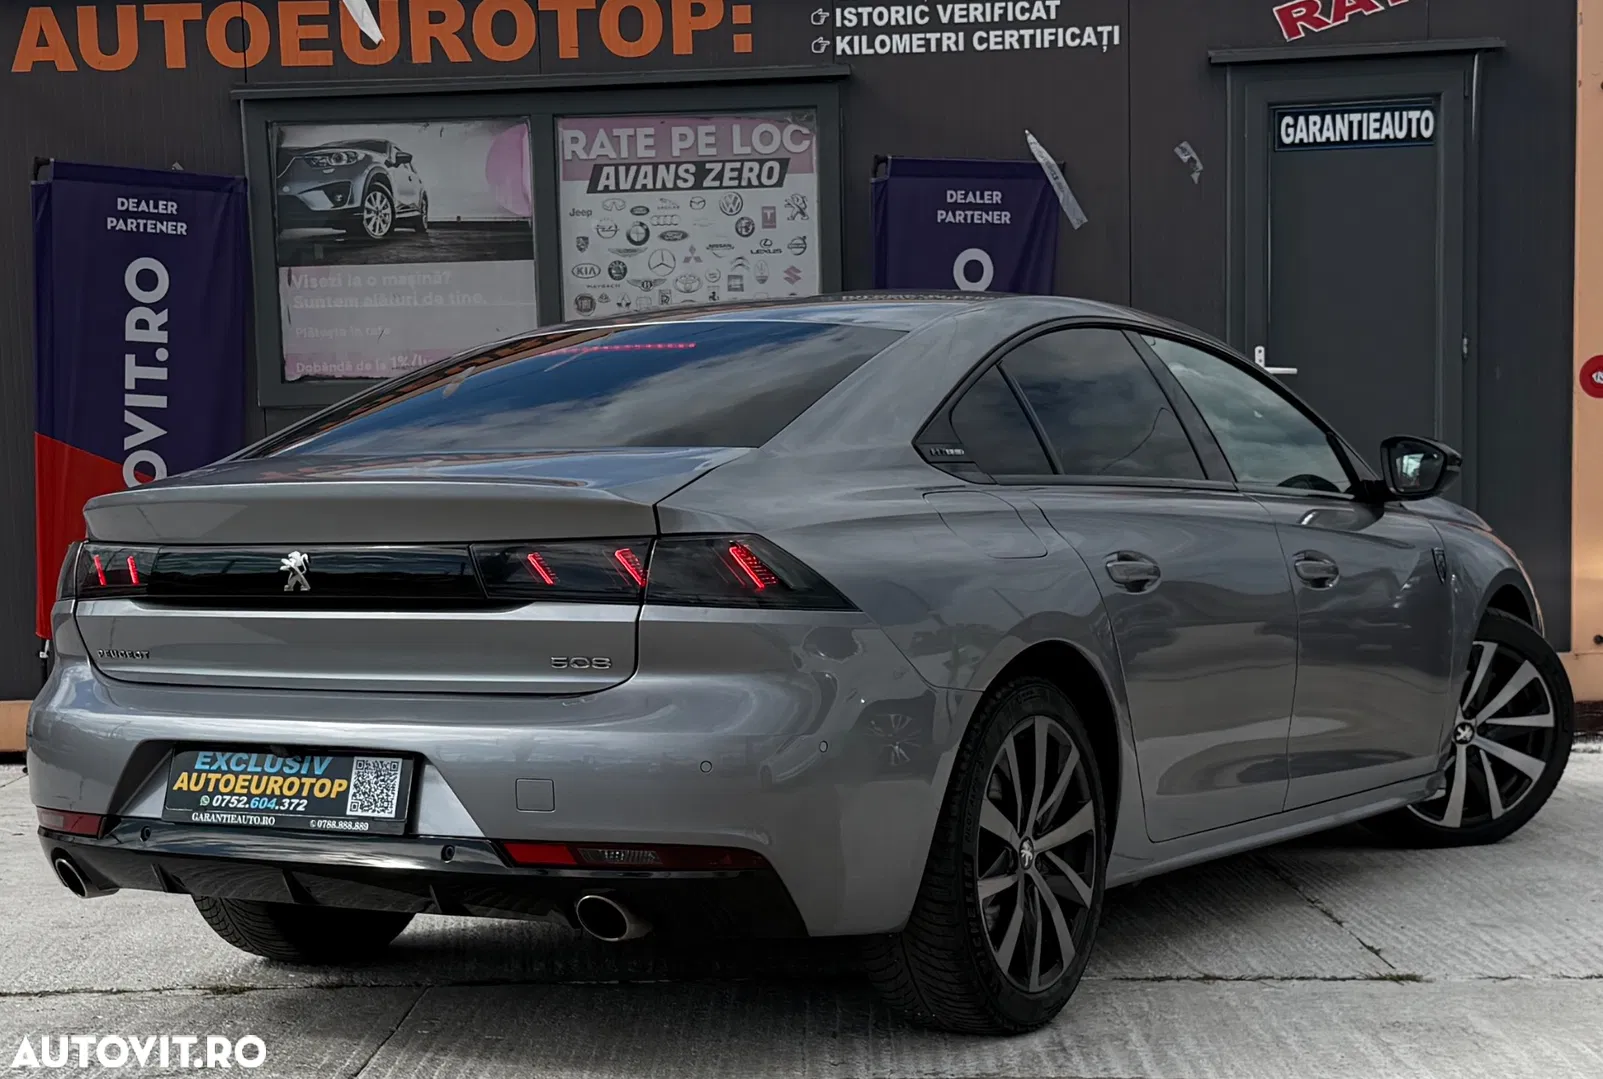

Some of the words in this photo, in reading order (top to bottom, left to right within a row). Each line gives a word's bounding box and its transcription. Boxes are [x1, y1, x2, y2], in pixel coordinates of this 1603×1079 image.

[836, 5, 930, 28] ISTORIC
[937, 0, 1061, 25] VERIFICAT
[1273, 0, 1409, 42] RA
[11, 0, 753, 72] AUTOEUROTOP:
[836, 32, 965, 56] KILOMETRI
[972, 25, 1120, 53] CERTIFICAȚI
[1280, 110, 1435, 145] GARANTIEAUTO
[563, 127, 656, 160] RATE
[671, 125, 718, 157] PE
[732, 123, 812, 155] LOC
[597, 163, 696, 191] AVANS
[703, 161, 781, 187] ZERO
[946, 190, 1003, 204] DEALER
[117, 197, 178, 215] DEALER
[569, 208, 593, 218] Jeep
[936, 210, 1011, 224] PARTENER
[107, 217, 188, 236] PARTENER
[576, 266, 597, 276] KIA
[347, 273, 363, 288] la
[366, 276, 378, 287] o
[423, 292, 444, 306] de
[356, 359, 371, 372] de
[375, 359, 387, 371] la
[97, 648, 150, 659] PEUGEOT
[550, 656, 612, 669] 508
[194, 751, 334, 776] EXCLUSIV
[172, 771, 348, 799] AUTOEUROTOP
[212, 794, 308, 811] 0752.604.372
[192, 812, 276, 826] GARANTIEAUTO.RO
